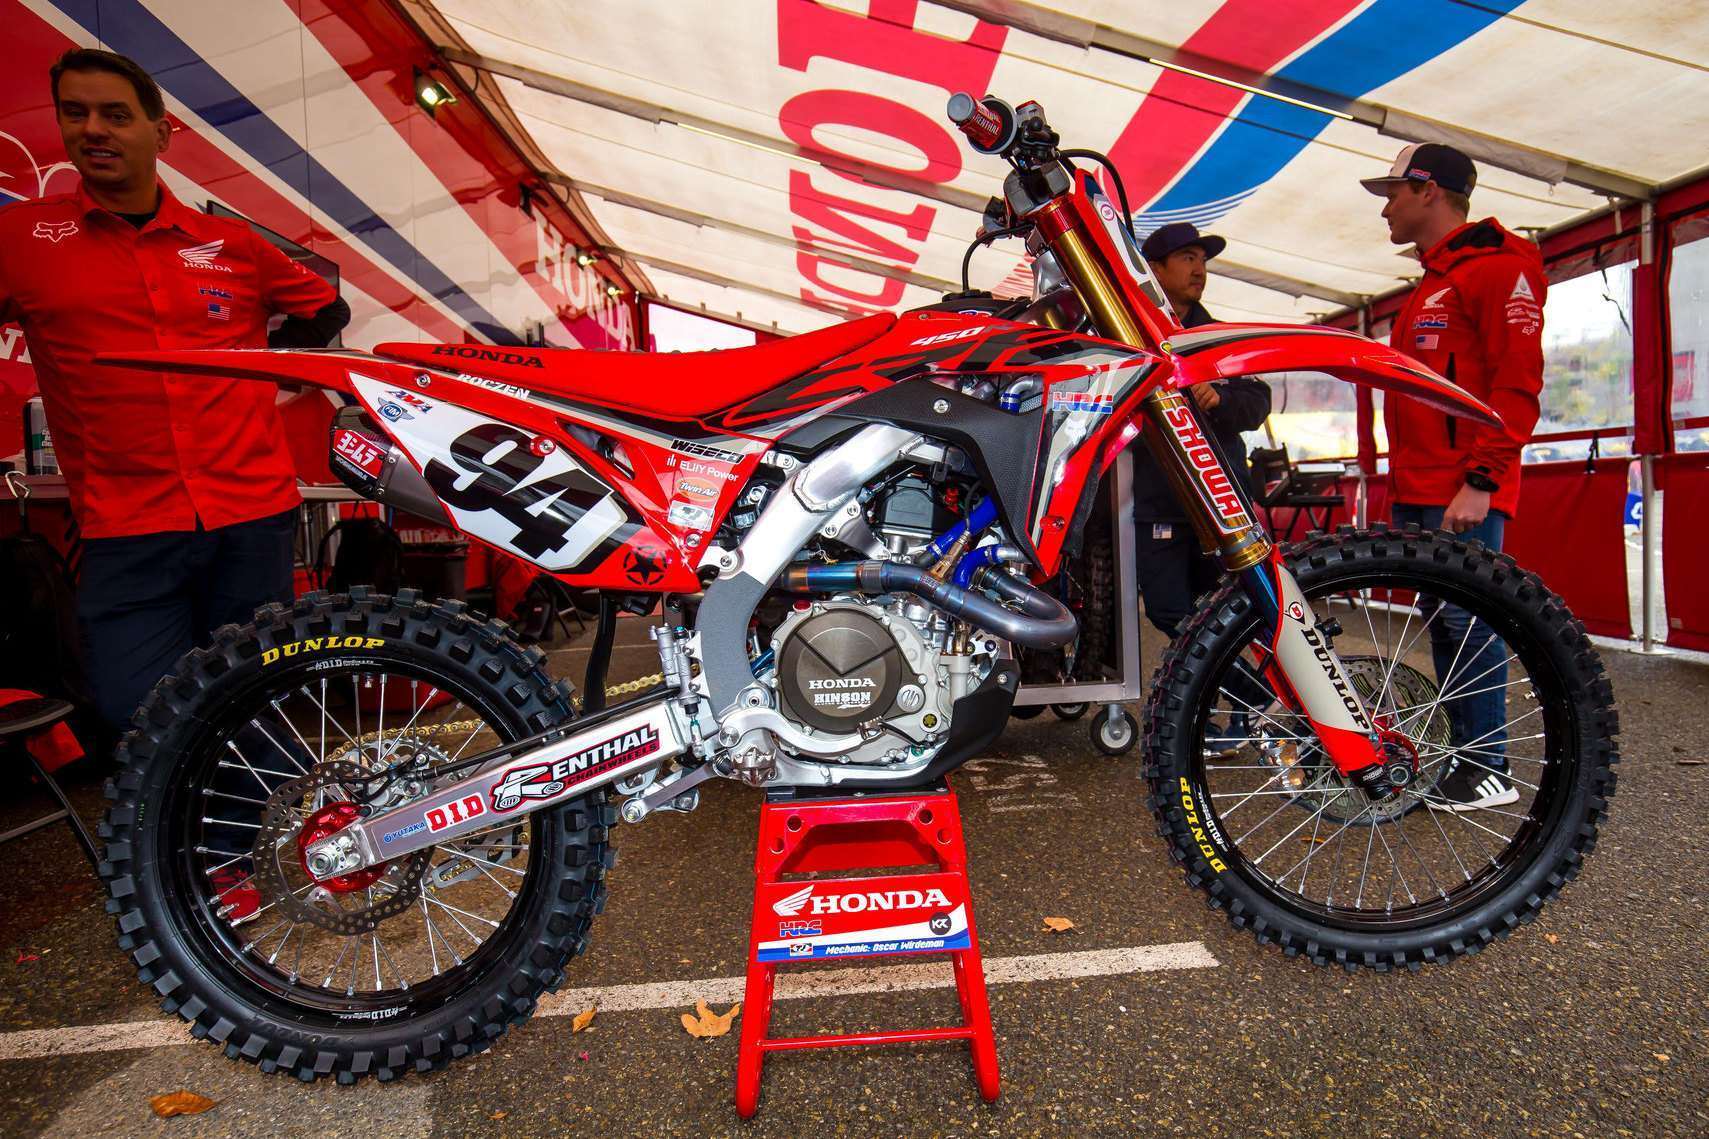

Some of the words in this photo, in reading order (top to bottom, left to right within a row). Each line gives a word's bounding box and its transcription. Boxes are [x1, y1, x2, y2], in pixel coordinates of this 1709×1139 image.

[183, 261, 233, 273] HONDA
[432, 347, 545, 369] HONDA
[457, 373, 530, 401] ROCZEN
[706, 466, 739, 482] Power
[1162, 406, 1245, 519] SHOWA
[423, 423, 614, 559] 94
[261, 635, 385, 666] DUNLOP
[809, 678, 876, 689] HONDA
[1301, 627, 1370, 730] DUNLOP
[814, 691, 871, 703] HINSON
[1180, 777, 1228, 873] DUNLOP
[810, 888, 952, 915] HONDA
[779, 920, 822, 937] HRC
[825, 943, 870, 955] Mechanic:
[872, 942, 898, 952] Oscar
